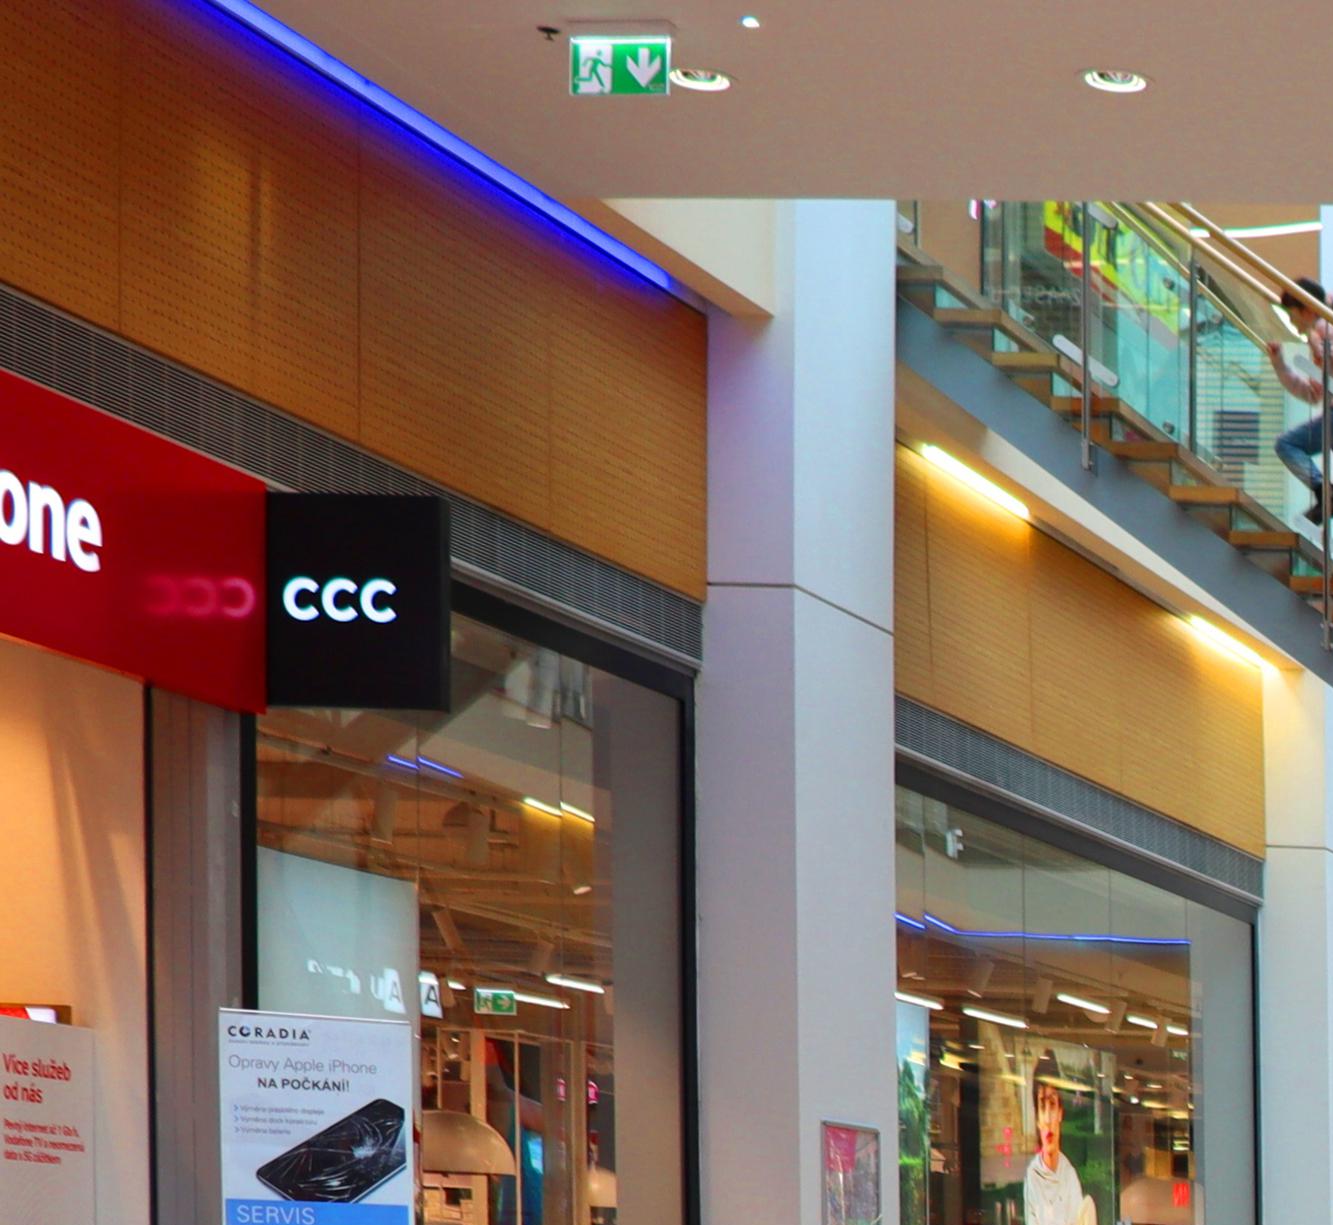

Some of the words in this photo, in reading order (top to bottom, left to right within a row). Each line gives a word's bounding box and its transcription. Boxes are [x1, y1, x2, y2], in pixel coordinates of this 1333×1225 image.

[0, 469, 102, 573] one
[282, 576, 398, 623] CCC
[227, 1025, 310, 1041] CORADIA
[3, 1053, 29, 1076] Více
[31, 1059, 71, 1082] služeb
[228, 1054, 280, 1073] Opravy
[283, 1056, 324, 1074] Apple
[328, 1059, 377, 1075] iPhone
[3, 1082, 18, 1101] od
[22, 1083, 43, 1103] nás
[257, 1078, 278, 1089] NA
[281, 1078, 350, 1092] POČKÁNÍ!
[236, 1204, 316, 1225] SERVIS
